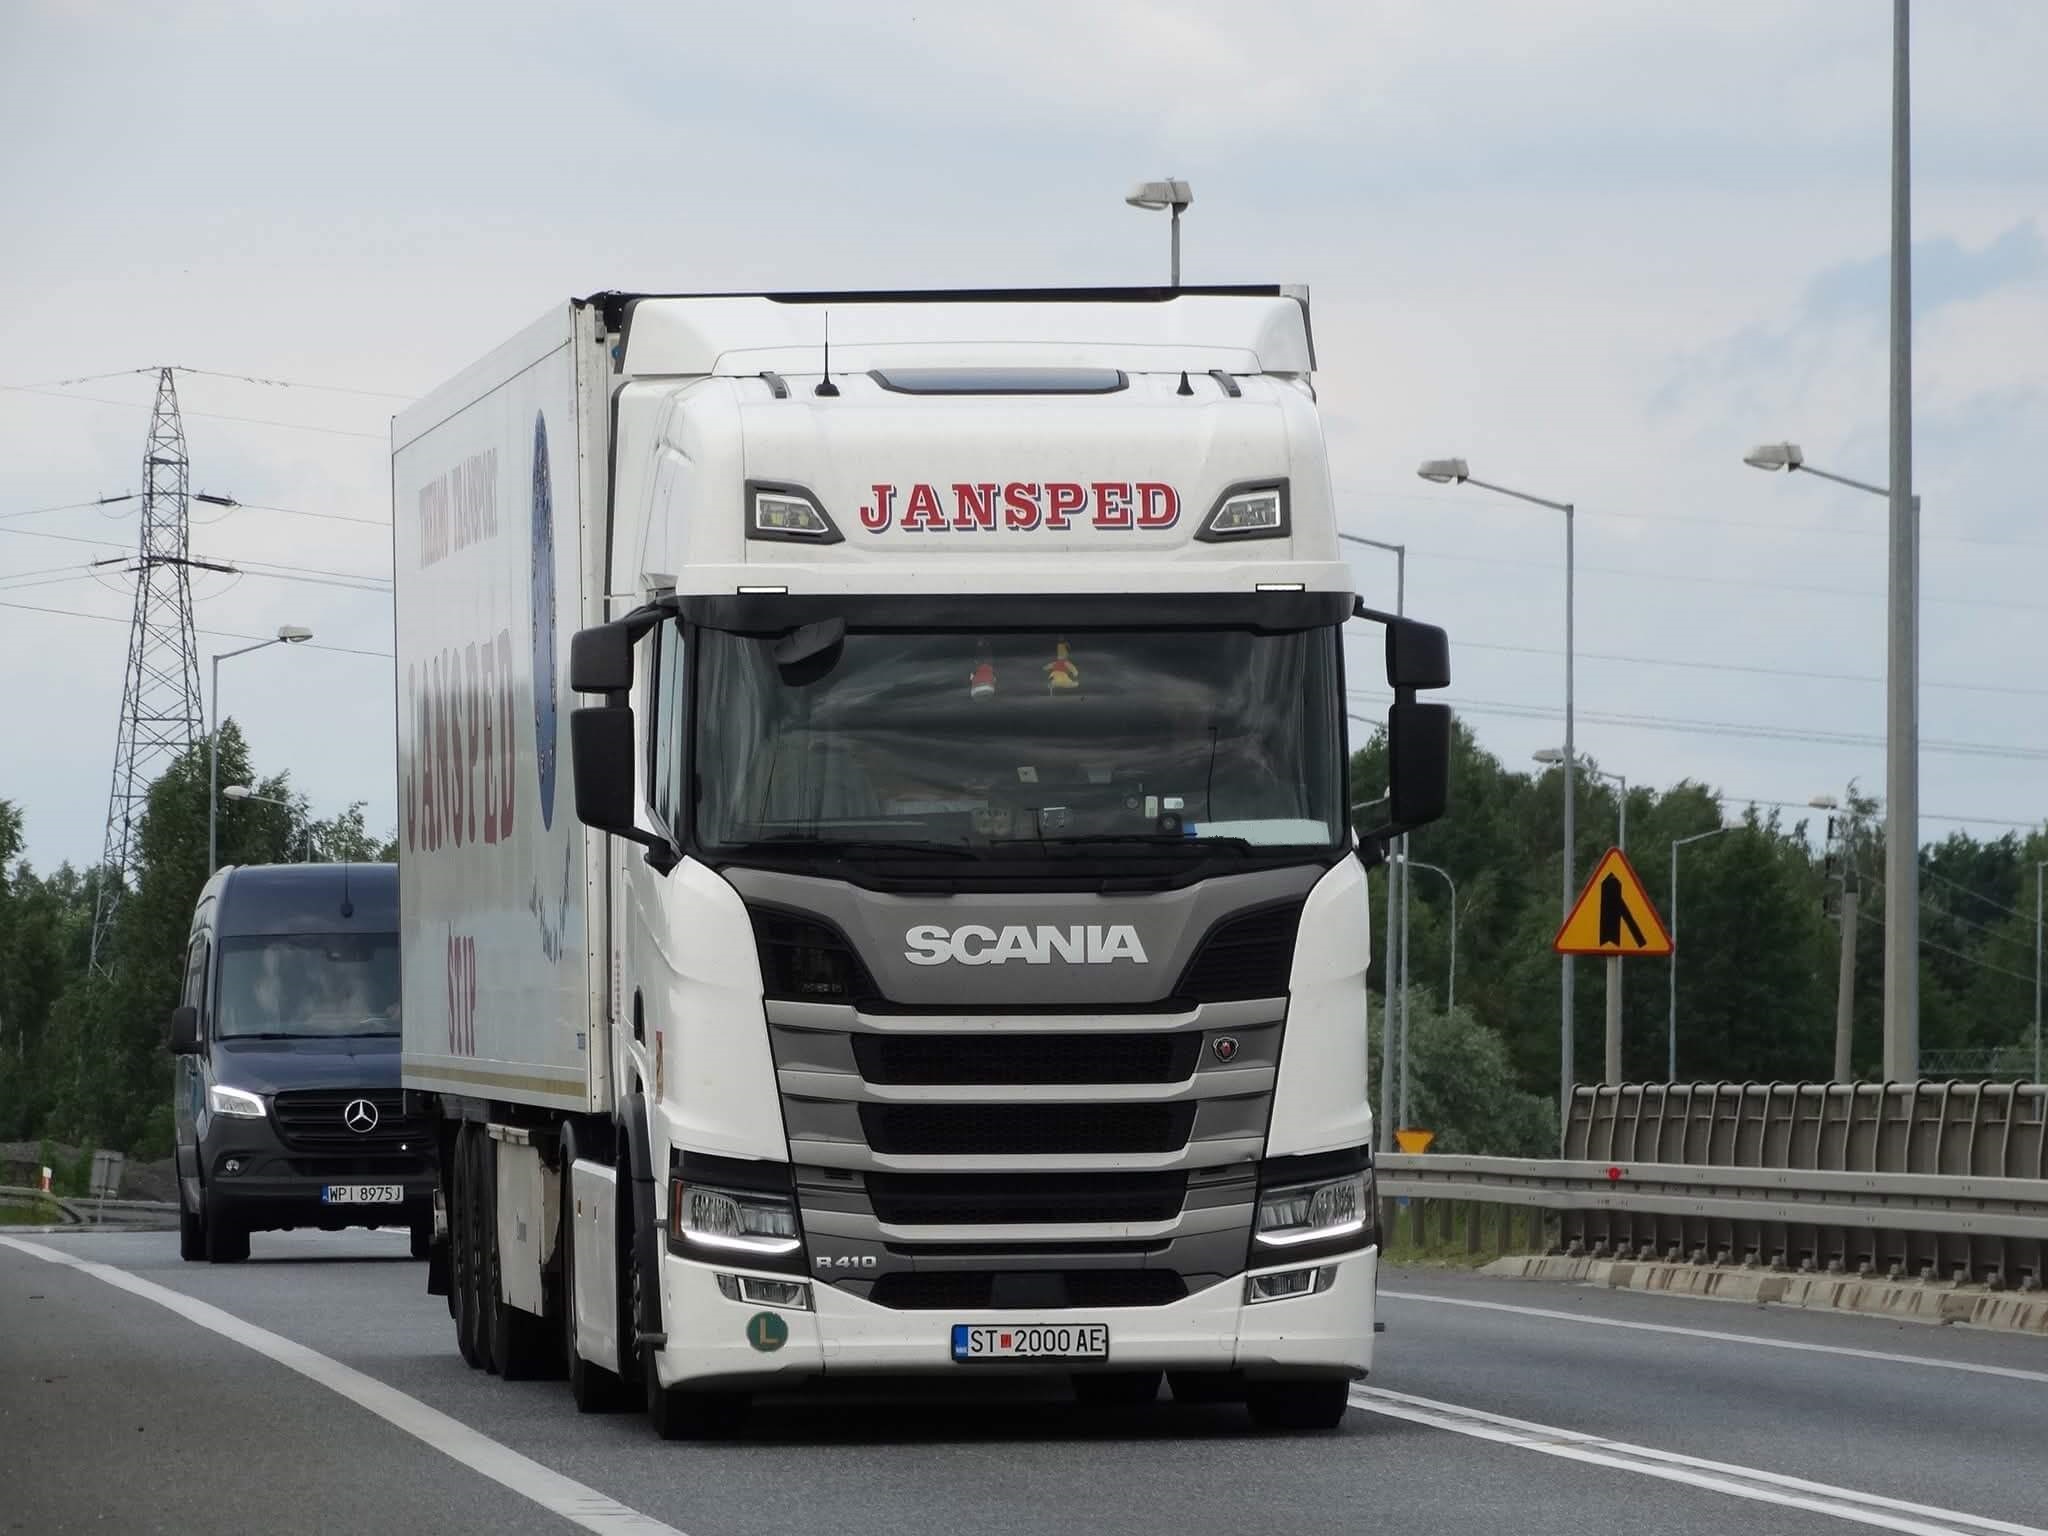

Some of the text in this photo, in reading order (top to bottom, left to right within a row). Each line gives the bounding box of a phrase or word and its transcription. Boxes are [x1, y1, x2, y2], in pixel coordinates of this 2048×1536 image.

[860, 482, 1181, 534] JANSPED
[407, 628, 516, 853] JANSPED
[904, 925, 1149, 966] SCANIA
[360, 1186, 400, 1201] 8975J
[816, 1256, 877, 1268] R 410
[760, 1318, 779, 1345] L
[970, 1329, 998, 1353] ST
